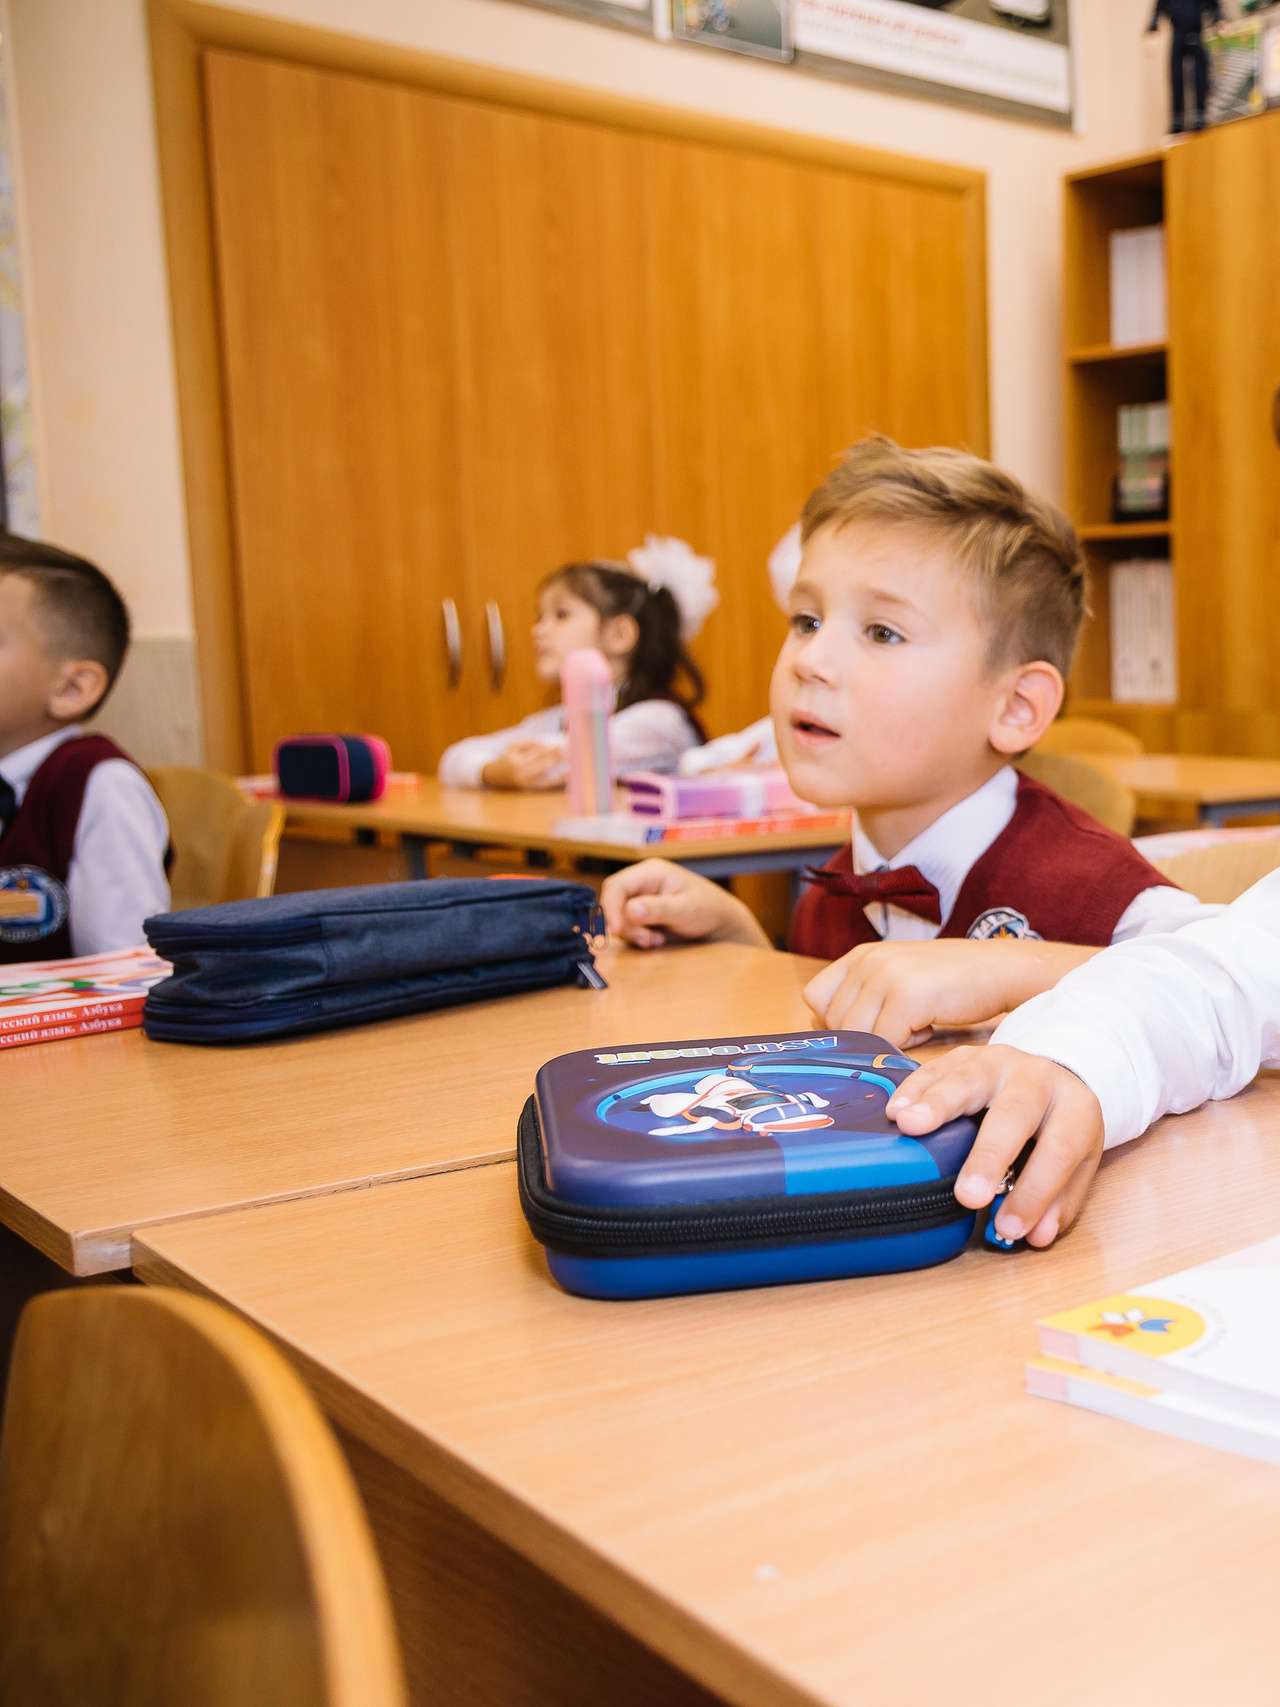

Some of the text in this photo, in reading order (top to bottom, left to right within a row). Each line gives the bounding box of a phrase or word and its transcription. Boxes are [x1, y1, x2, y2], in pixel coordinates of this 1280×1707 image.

[0, 1014, 40, 1029] сский
[81, 1003, 123, 1017] Азбука
[0, 1029, 38, 1045] сский
[80, 1018, 122, 1031] Азбука
[593, 1036, 838, 1065] Astronaut
